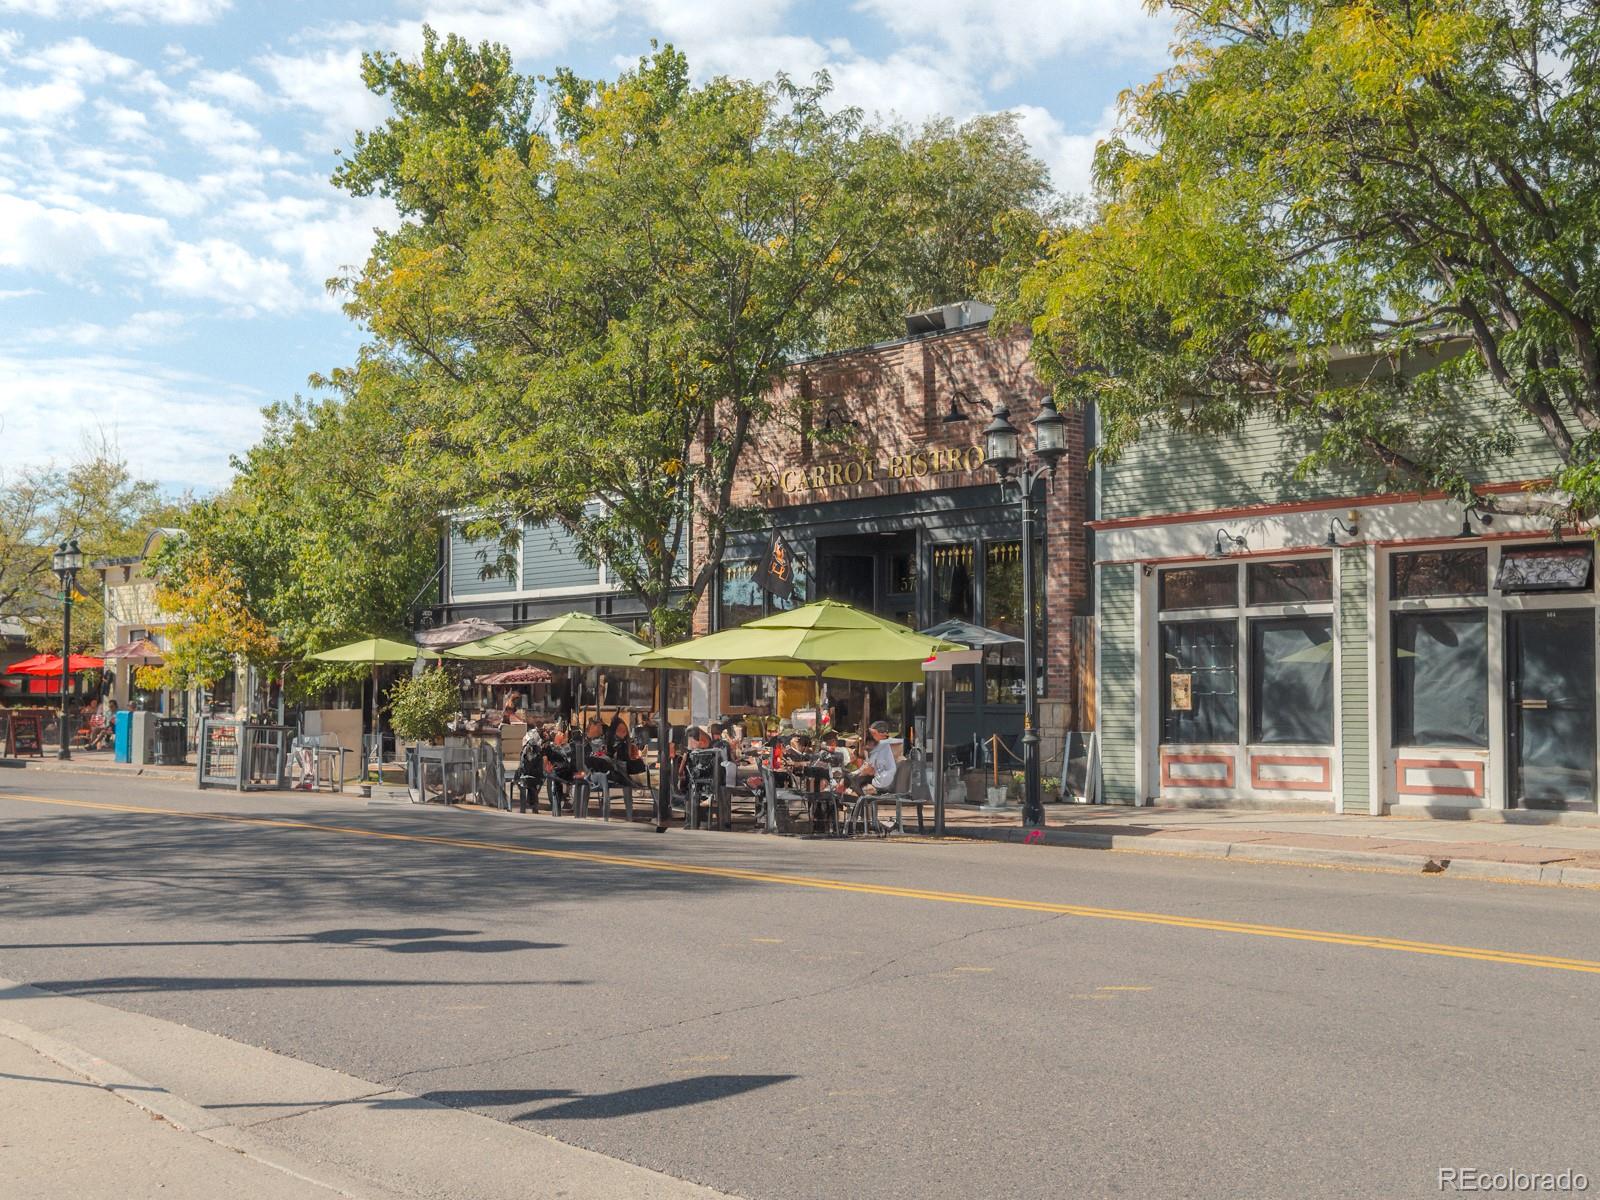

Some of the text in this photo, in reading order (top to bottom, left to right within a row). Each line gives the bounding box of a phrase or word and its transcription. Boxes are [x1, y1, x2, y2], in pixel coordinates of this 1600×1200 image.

[751, 445, 985, 496] 24 CARROT BISTRO
